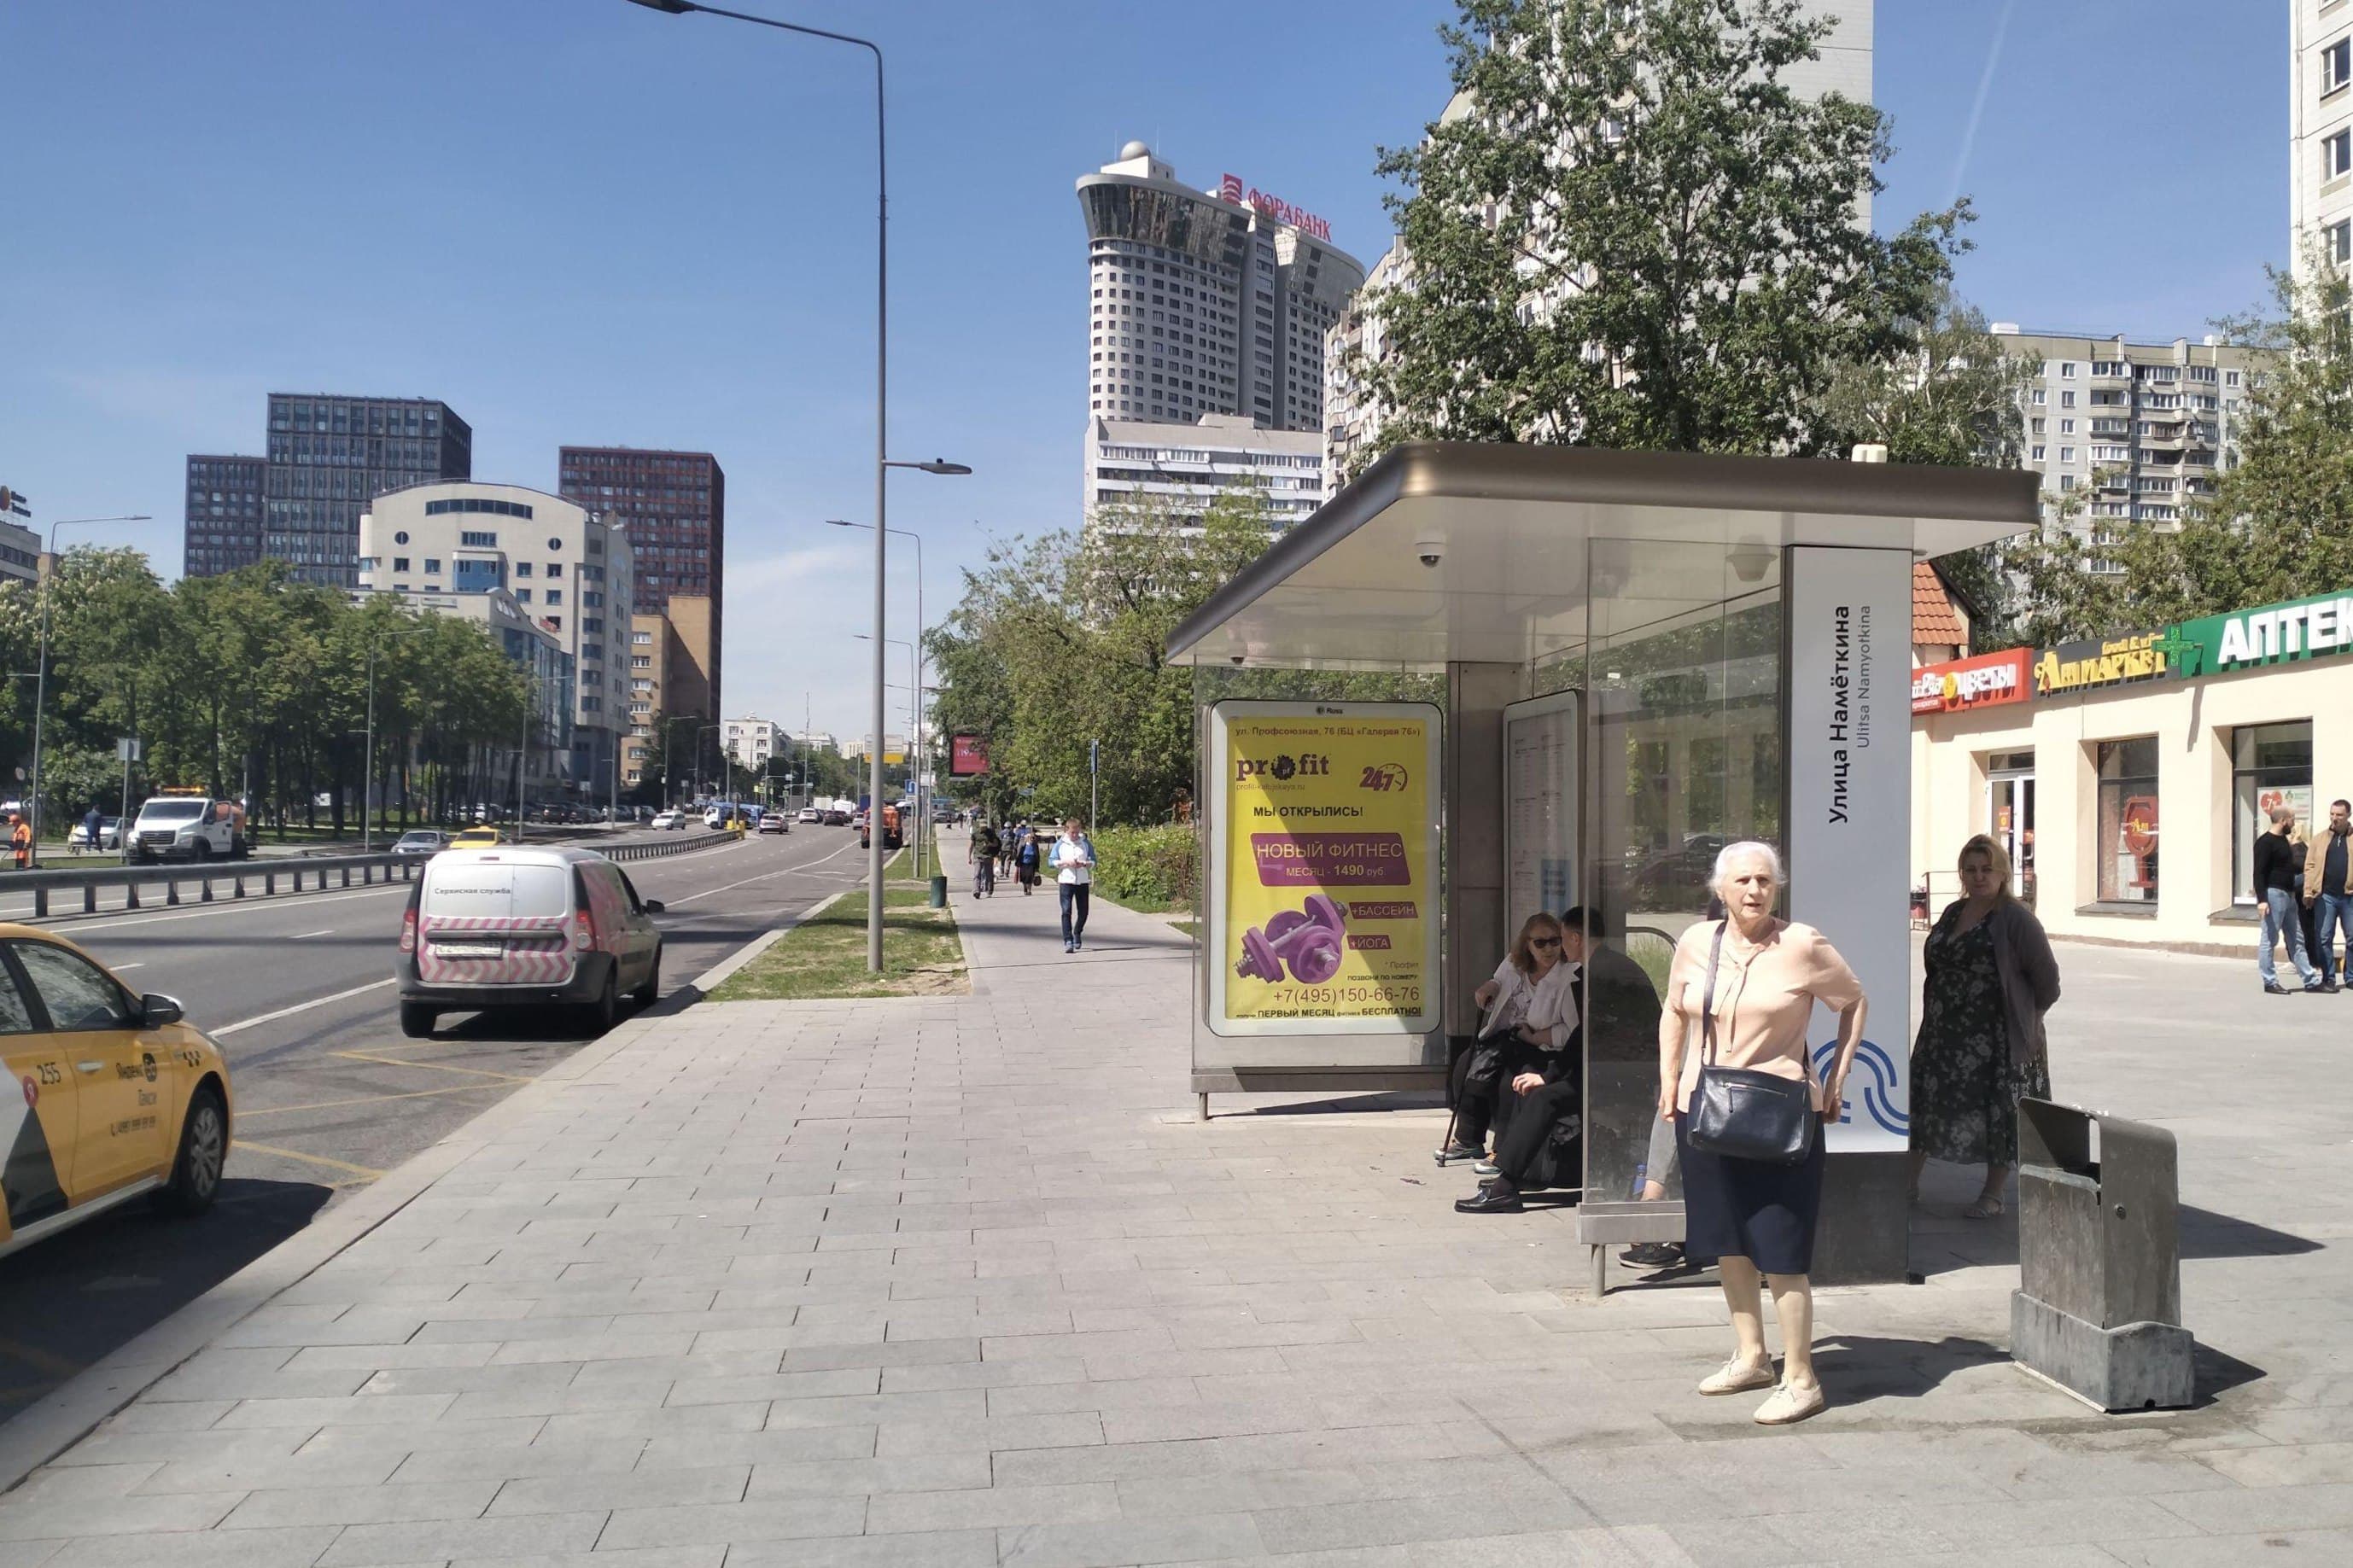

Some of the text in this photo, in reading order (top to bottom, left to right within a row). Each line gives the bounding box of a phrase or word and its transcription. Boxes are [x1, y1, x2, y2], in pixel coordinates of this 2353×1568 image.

[1248, 188, 1332, 242] ФОРАБАНК
[1856, 605, 1871, 748] Ulitsa Namyotkina
[1829, 605, 1850, 824] Улица Намёткина
[1253, 807, 1363, 817] МЫ ОТКРЫЛИСЬ!
[1257, 841, 1402, 858] НОВЫЙ ФИТНЕС
[1287, 867, 1324, 877] МЕСЯЦ
[1334, 865, 1364, 877] 1490
[1352, 903, 1415, 916] +БАССЕЙН
[1350, 936, 1388, 949] +ЙОГА
[1274, 987, 1420, 1006] +7(495)150-66-76
[1258, 1008, 1299, 1017] ПЕРВЫЙ
[1301, 1008, 1335, 1017] МЕСЯЦ
[37, 1062, 61, 1085] 255
